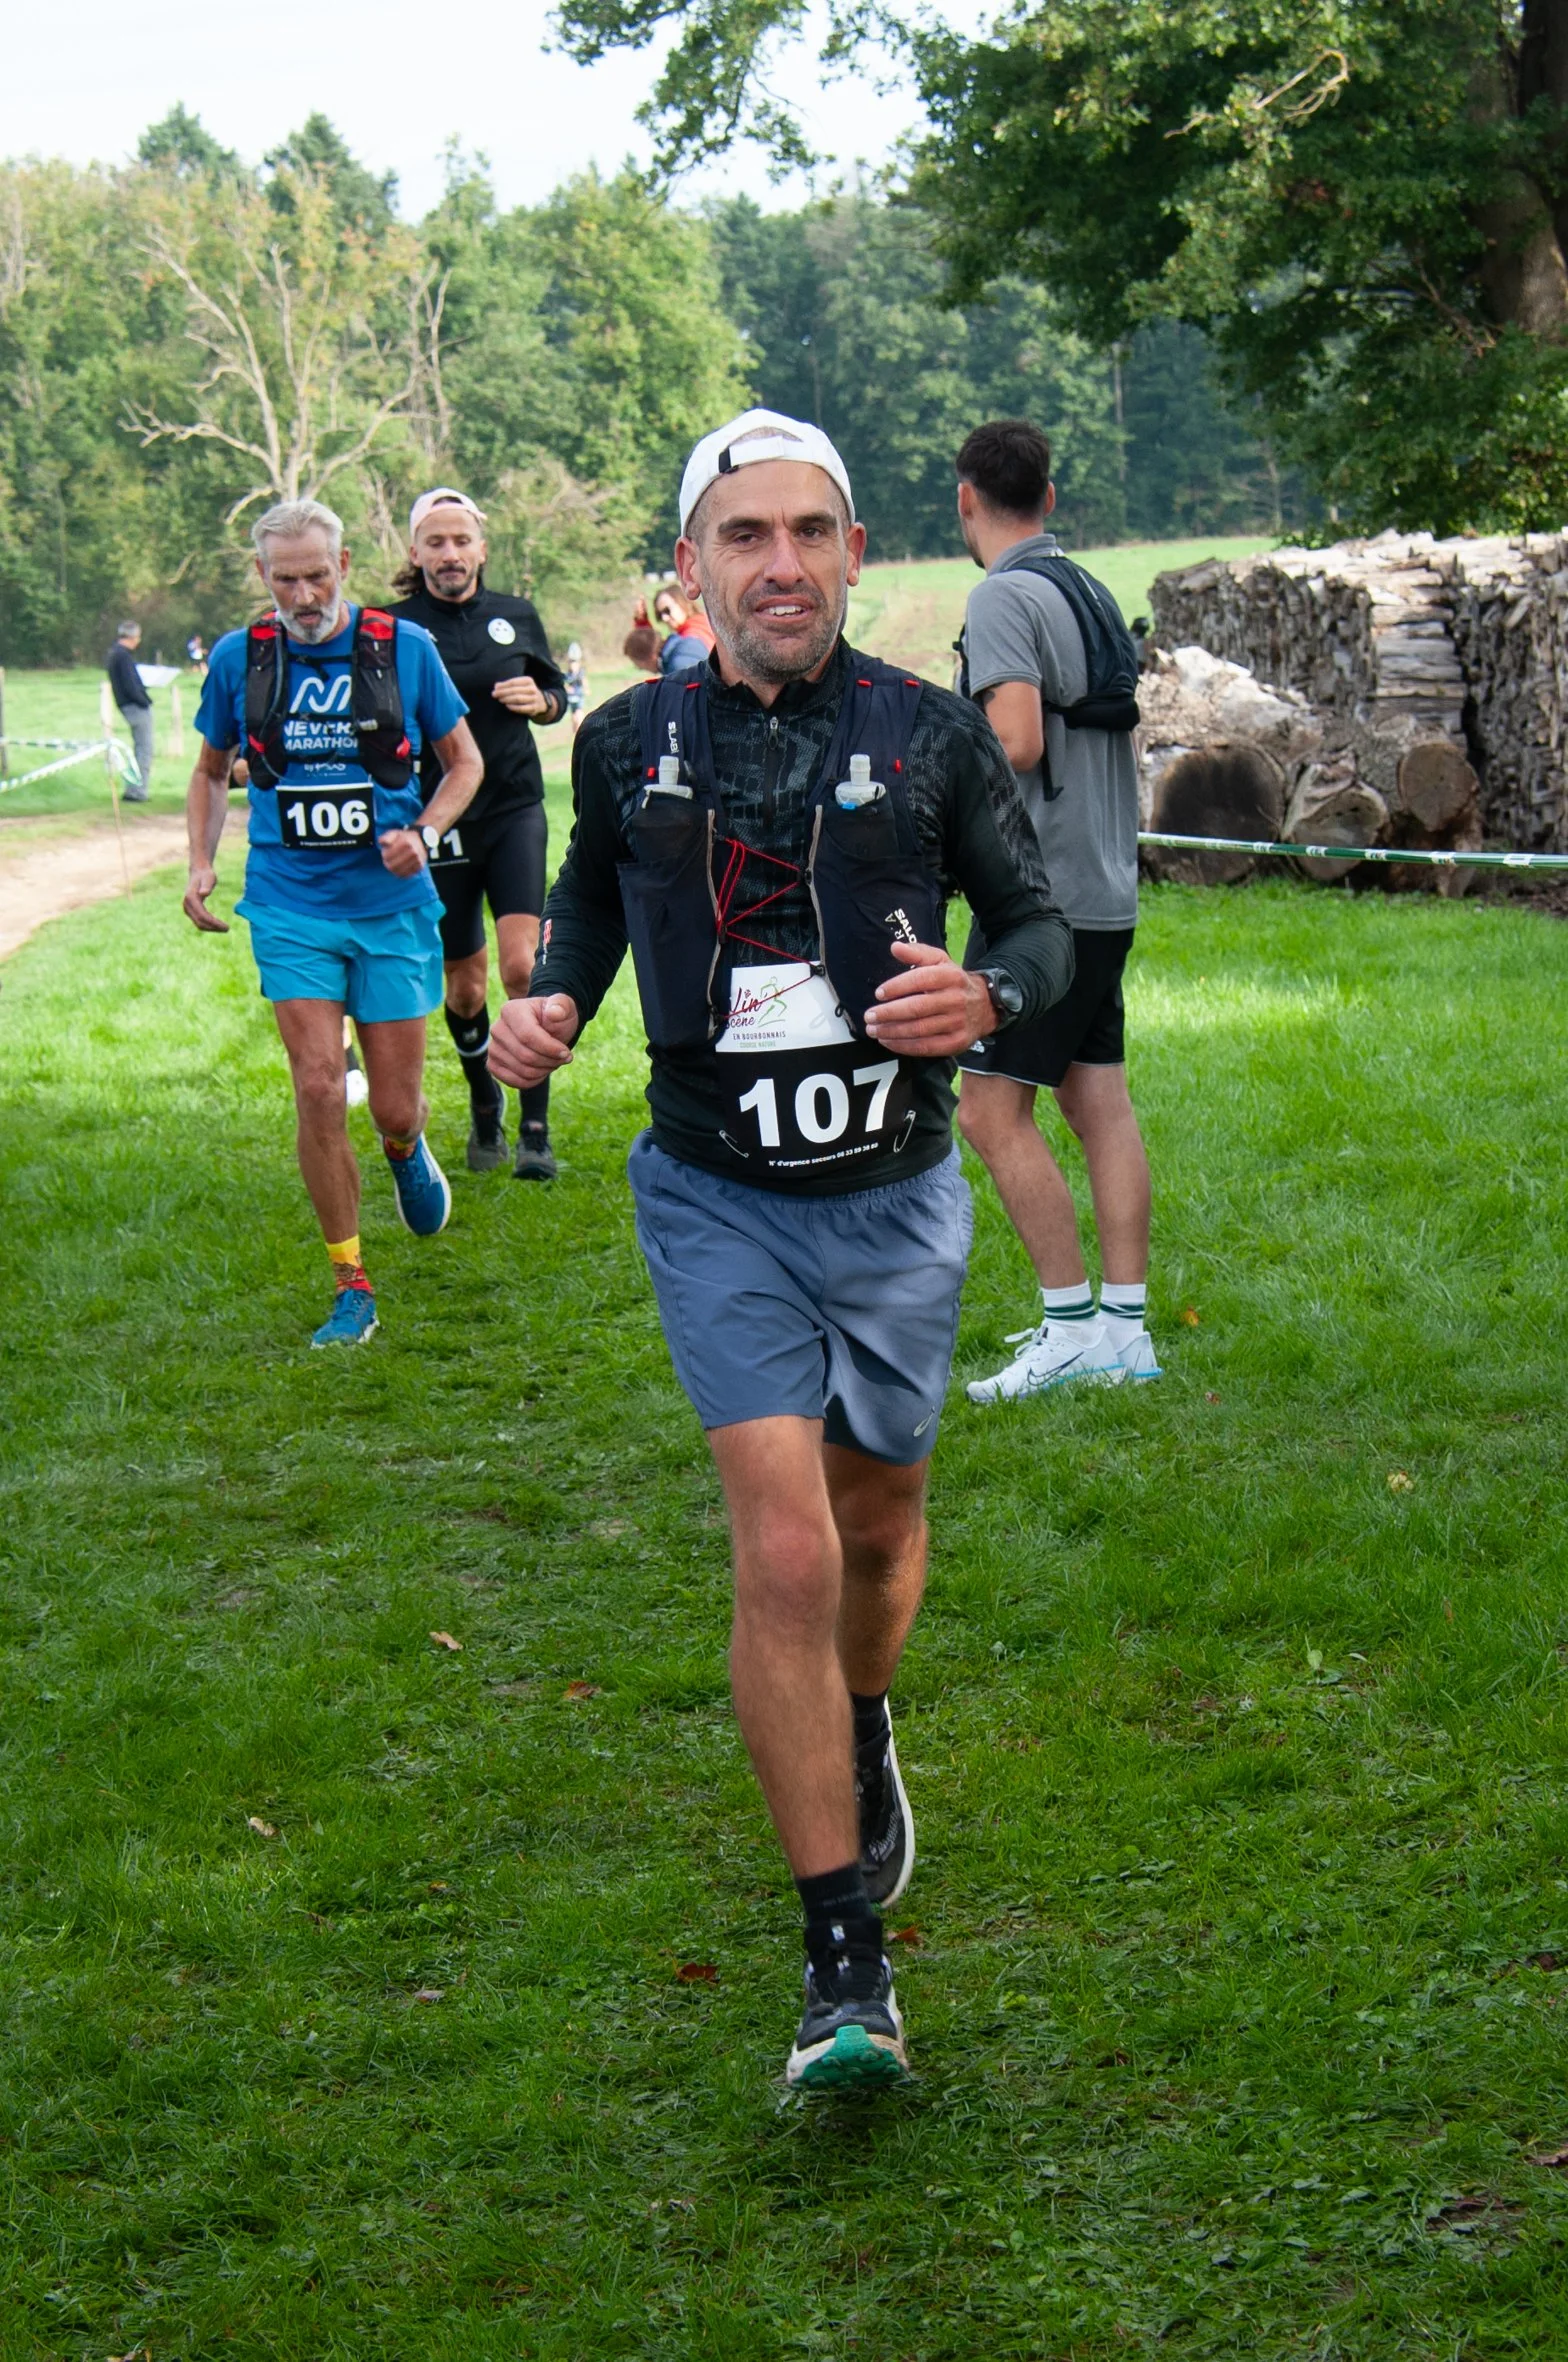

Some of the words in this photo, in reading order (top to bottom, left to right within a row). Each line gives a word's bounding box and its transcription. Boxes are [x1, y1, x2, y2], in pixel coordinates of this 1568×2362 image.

[287, 800, 369, 837] 106
[894, 908, 918, 943] SALO
[732, 1033, 741, 1041] EN
[742, 1031, 786, 1041] BOURBONNAIS
[739, 1059, 899, 1147] 107
[777, 1158, 810, 1168] d'urgence
[812, 1154, 836, 1165] secours
